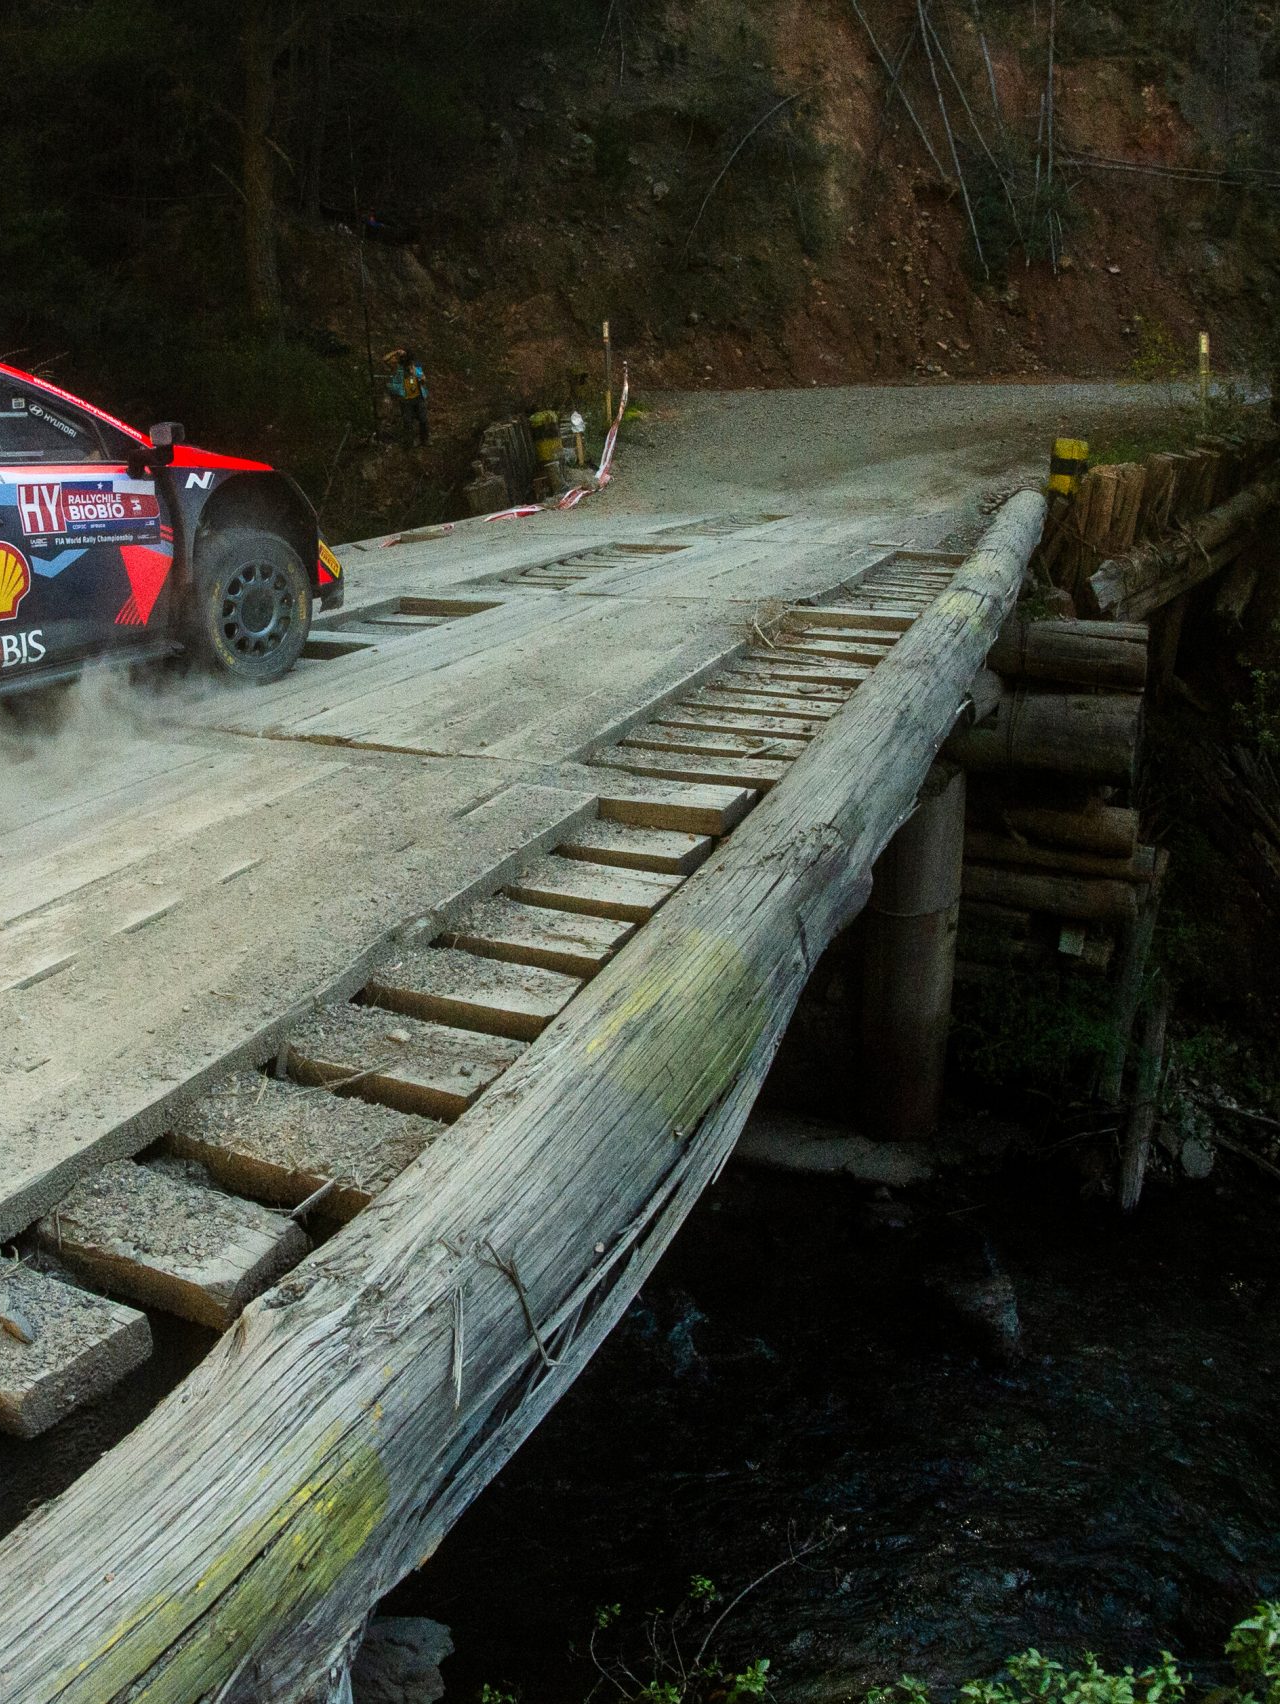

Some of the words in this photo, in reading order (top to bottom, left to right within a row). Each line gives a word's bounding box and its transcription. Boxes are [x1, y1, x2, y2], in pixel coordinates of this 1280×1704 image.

[43, 412, 78, 439] HYUNDAI
[19, 485, 61, 532] HY
[55, 537, 64, 546] FIA
[65, 536, 82, 545] World
[82, 535, 96, 544] Rally
[97, 533, 134, 543] Championship
